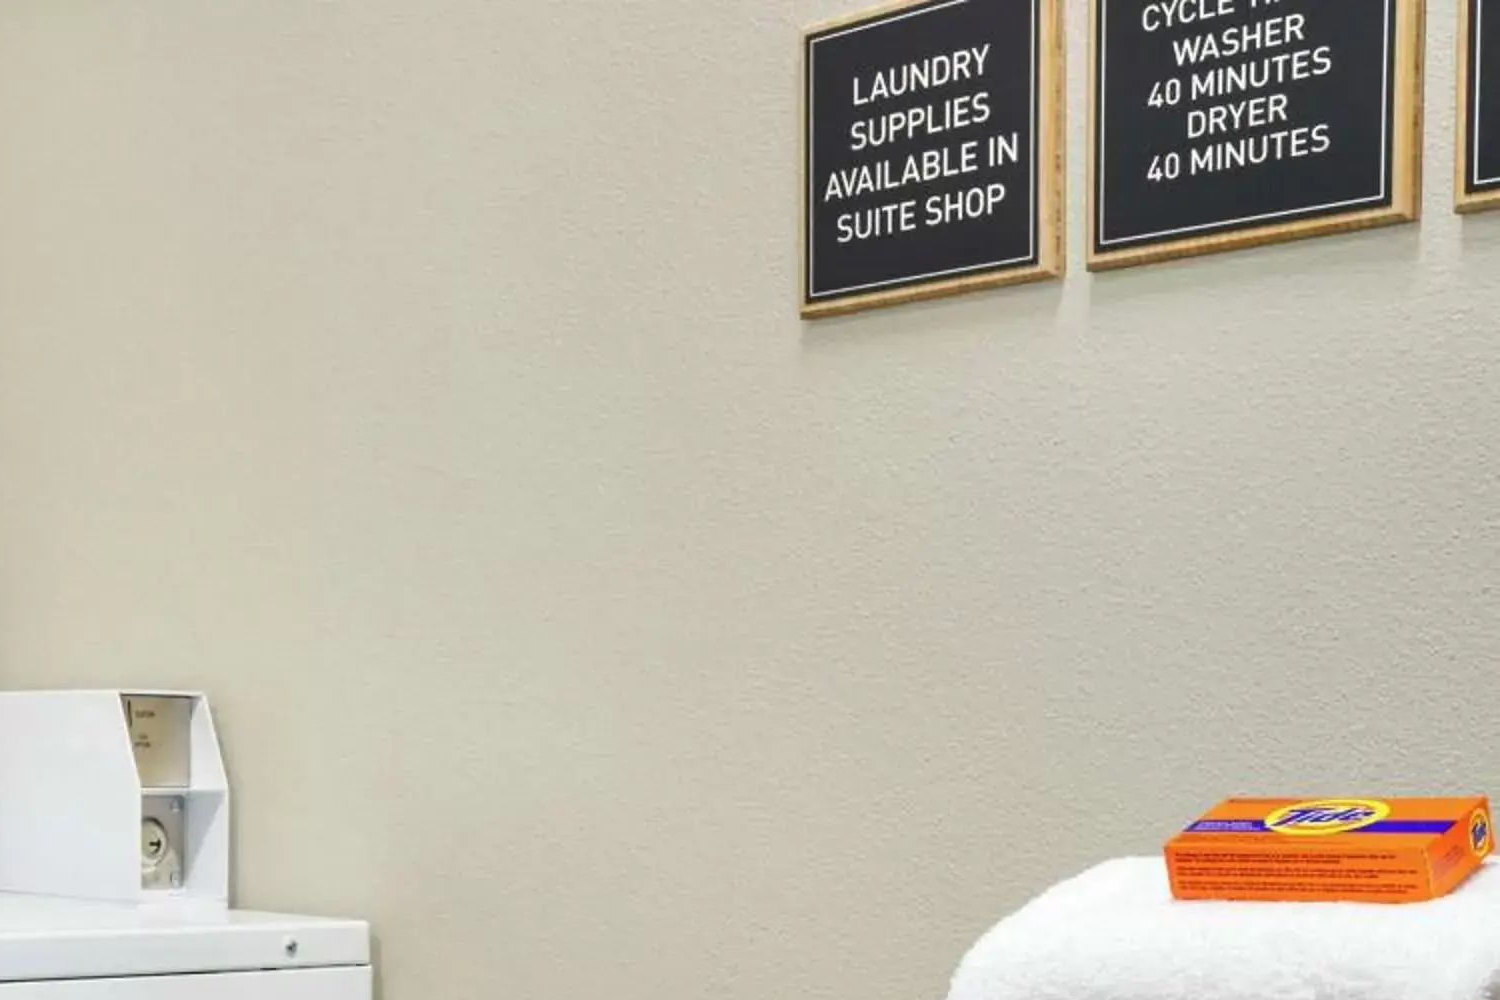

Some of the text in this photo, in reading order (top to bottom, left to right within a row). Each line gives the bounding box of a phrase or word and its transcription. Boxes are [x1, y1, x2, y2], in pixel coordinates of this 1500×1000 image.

[1142, 0, 1235, 32] CYCLE
[1173, 13, 1305, 66] WASHER
[853, 44, 990, 106] LAUNDRY
[1148, 46, 1332, 108] 40 MINUTES
[851, 92, 990, 150] SUPPLIES
[1187, 94, 1288, 139] DRYER
[824, 132, 1018, 202] AVAILABLE IN
[1147, 124, 1331, 182] 40 MINUTES
[837, 183, 1005, 243] SUITE SHOP
[1272, 807, 1375, 827] Tide
